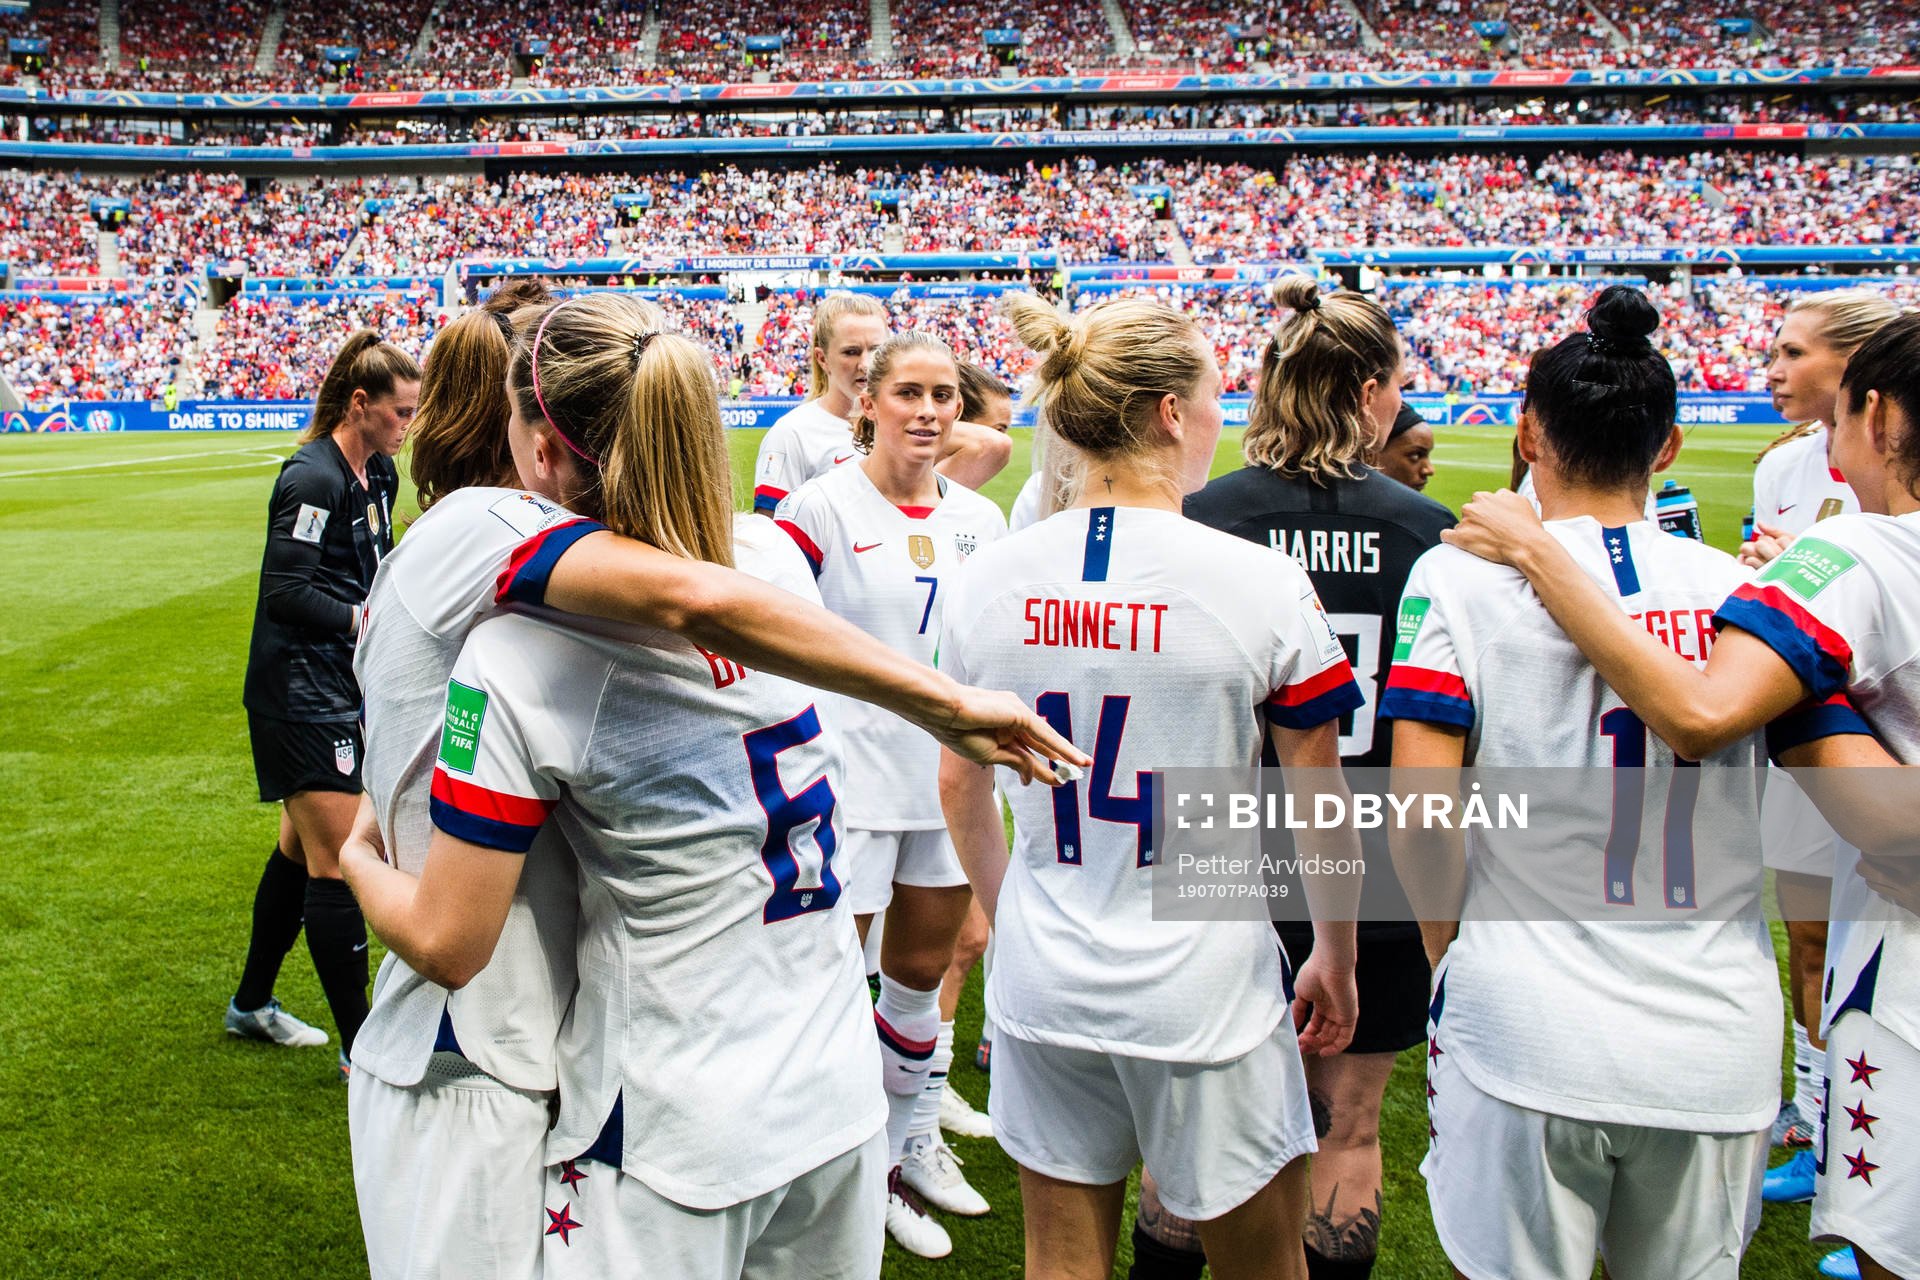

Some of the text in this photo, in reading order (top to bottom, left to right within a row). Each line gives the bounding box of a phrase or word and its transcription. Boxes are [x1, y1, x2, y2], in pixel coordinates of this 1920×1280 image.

[522, 144, 545, 154] LYON
[692, 259, 705, 269] LE
[706, 259, 753, 269] MOMENT
[754, 258, 768, 268] DE
[168, 412, 216, 429] DARE
[217, 412, 243, 429] TO
[1269, 529, 1381, 574] HARRIS
[915, 576, 938, 634] 7
[1023, 597, 1168, 653] SONNETT
[1628, 608, 1717, 661] GER
[450, 734, 474, 751] FIFA
[1036, 690, 1165, 869] 14
[742, 702, 842, 926] 6
